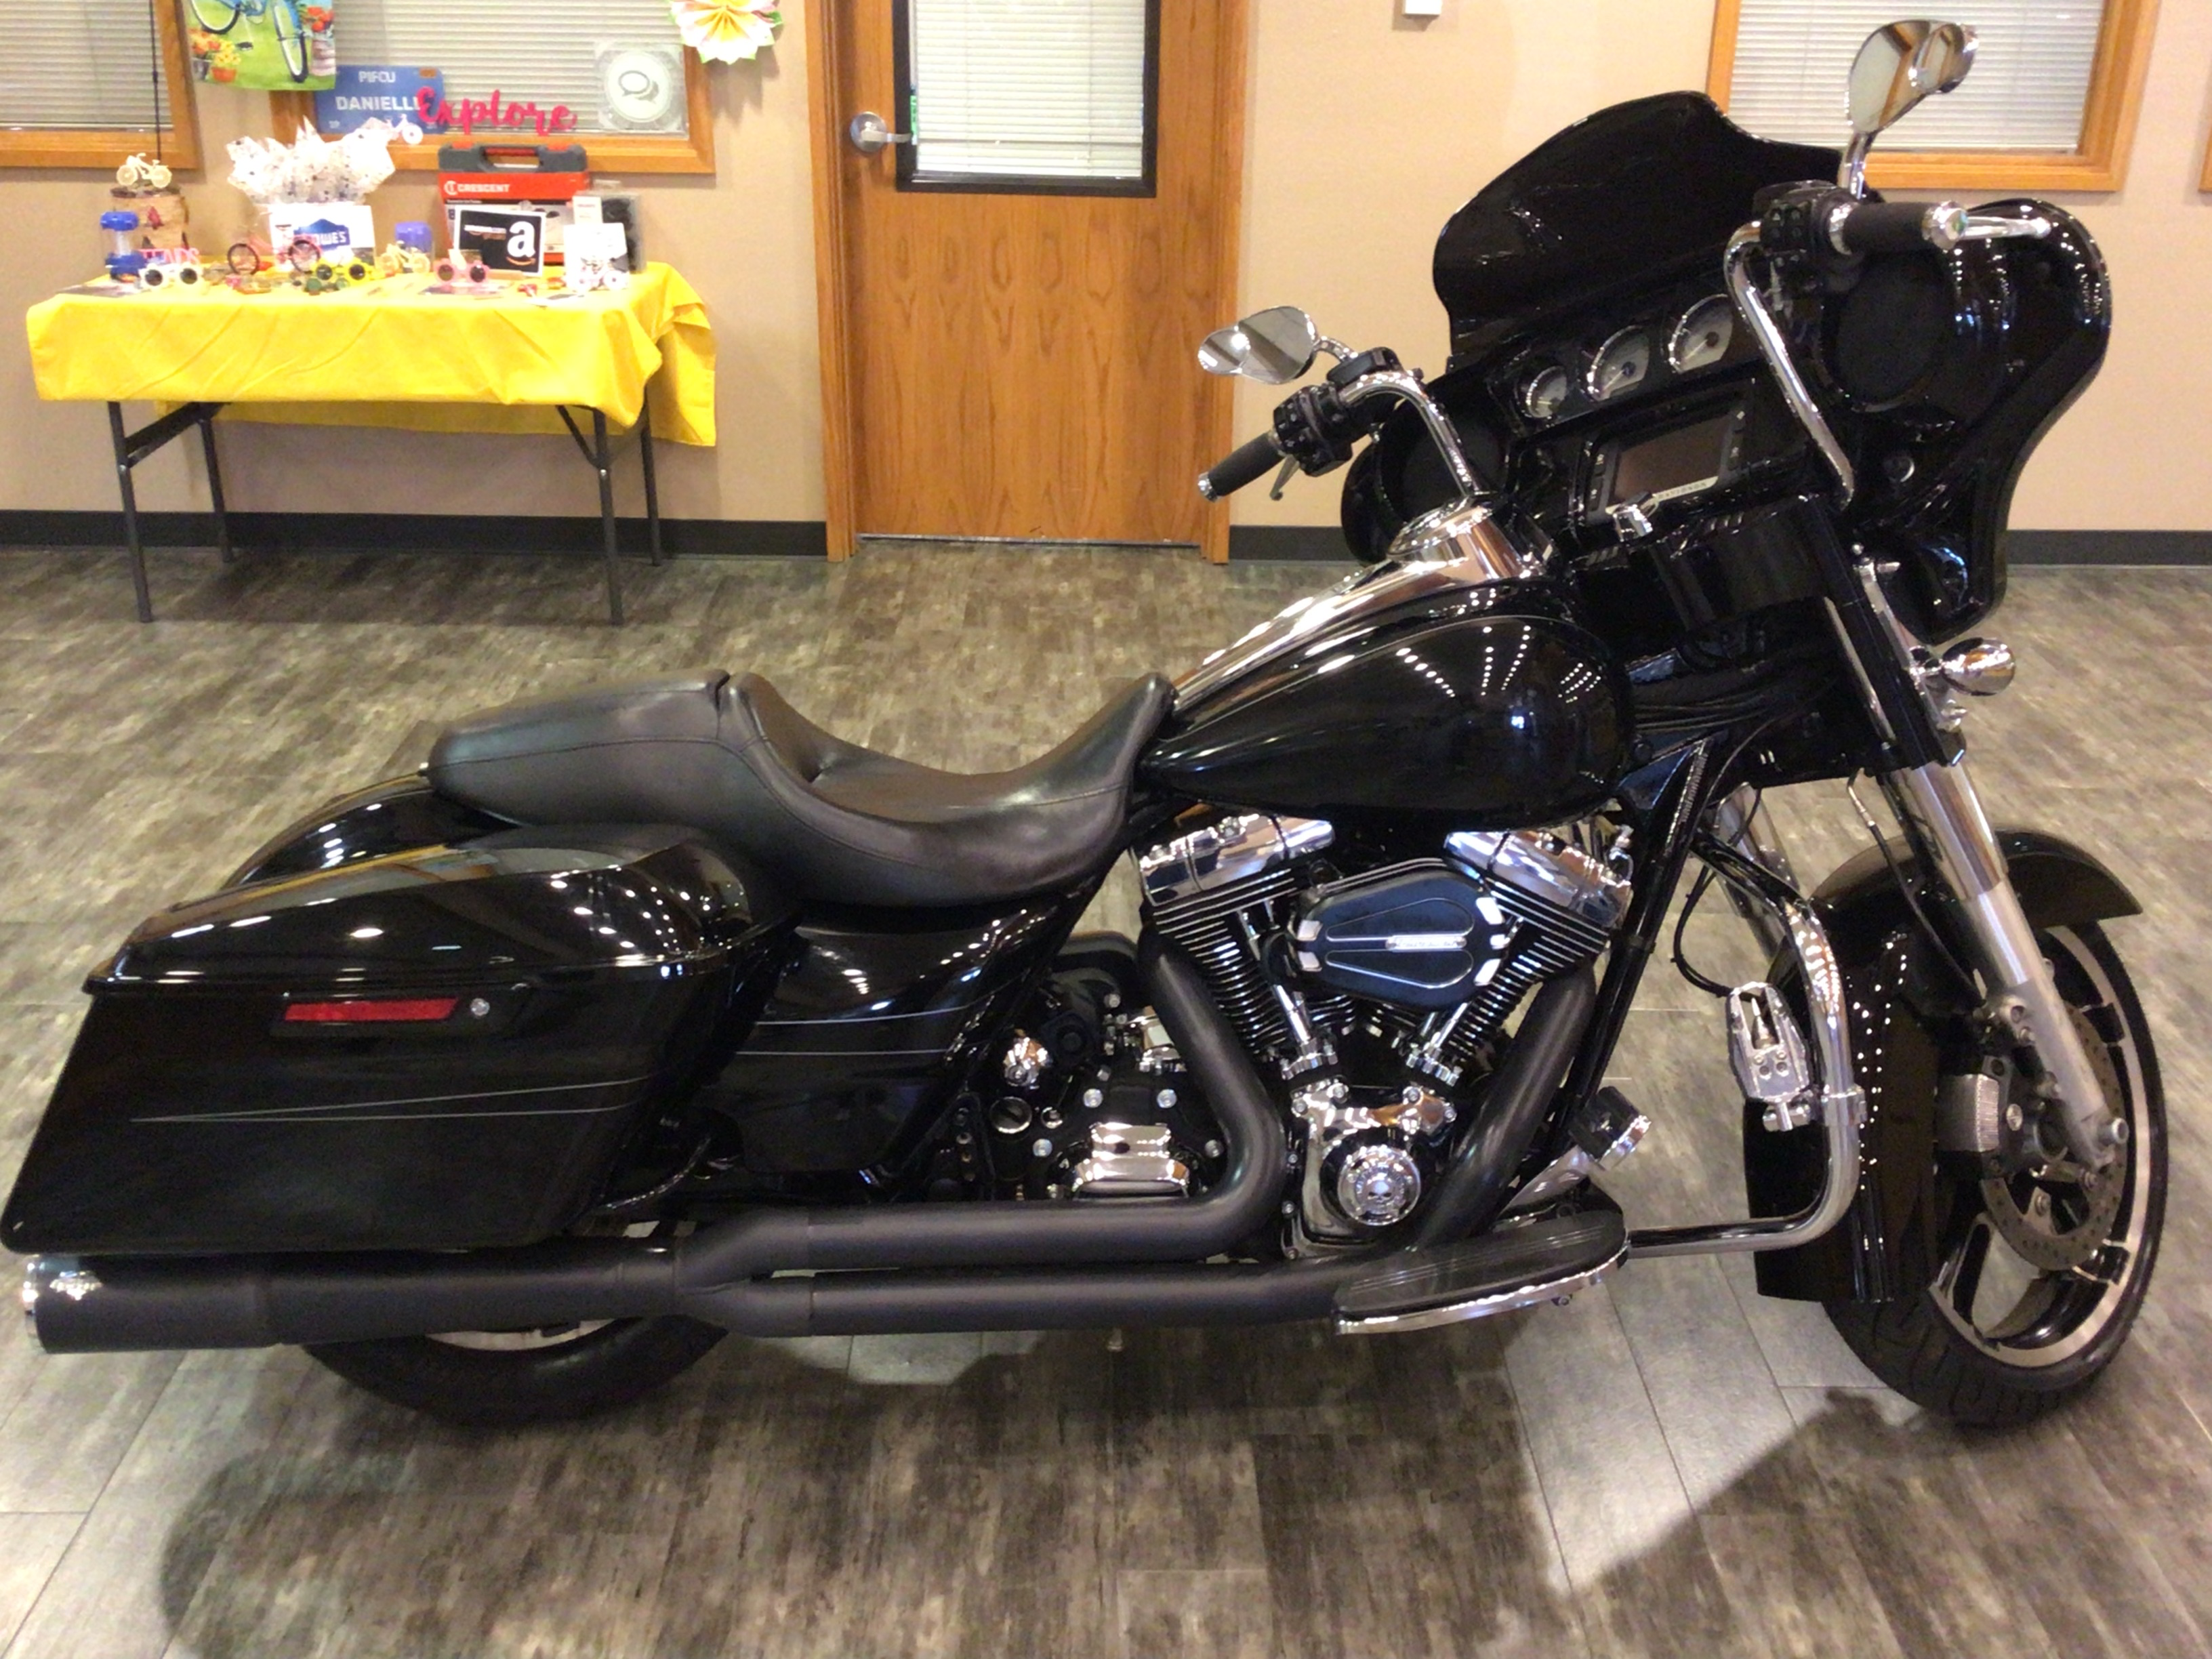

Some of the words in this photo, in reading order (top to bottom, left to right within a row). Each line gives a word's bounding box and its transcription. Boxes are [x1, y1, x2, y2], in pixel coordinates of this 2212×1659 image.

[415, 85, 578, 137] Explore
[457, 184, 510, 193] CRESCENT
[507, 220, 536, 258] a
